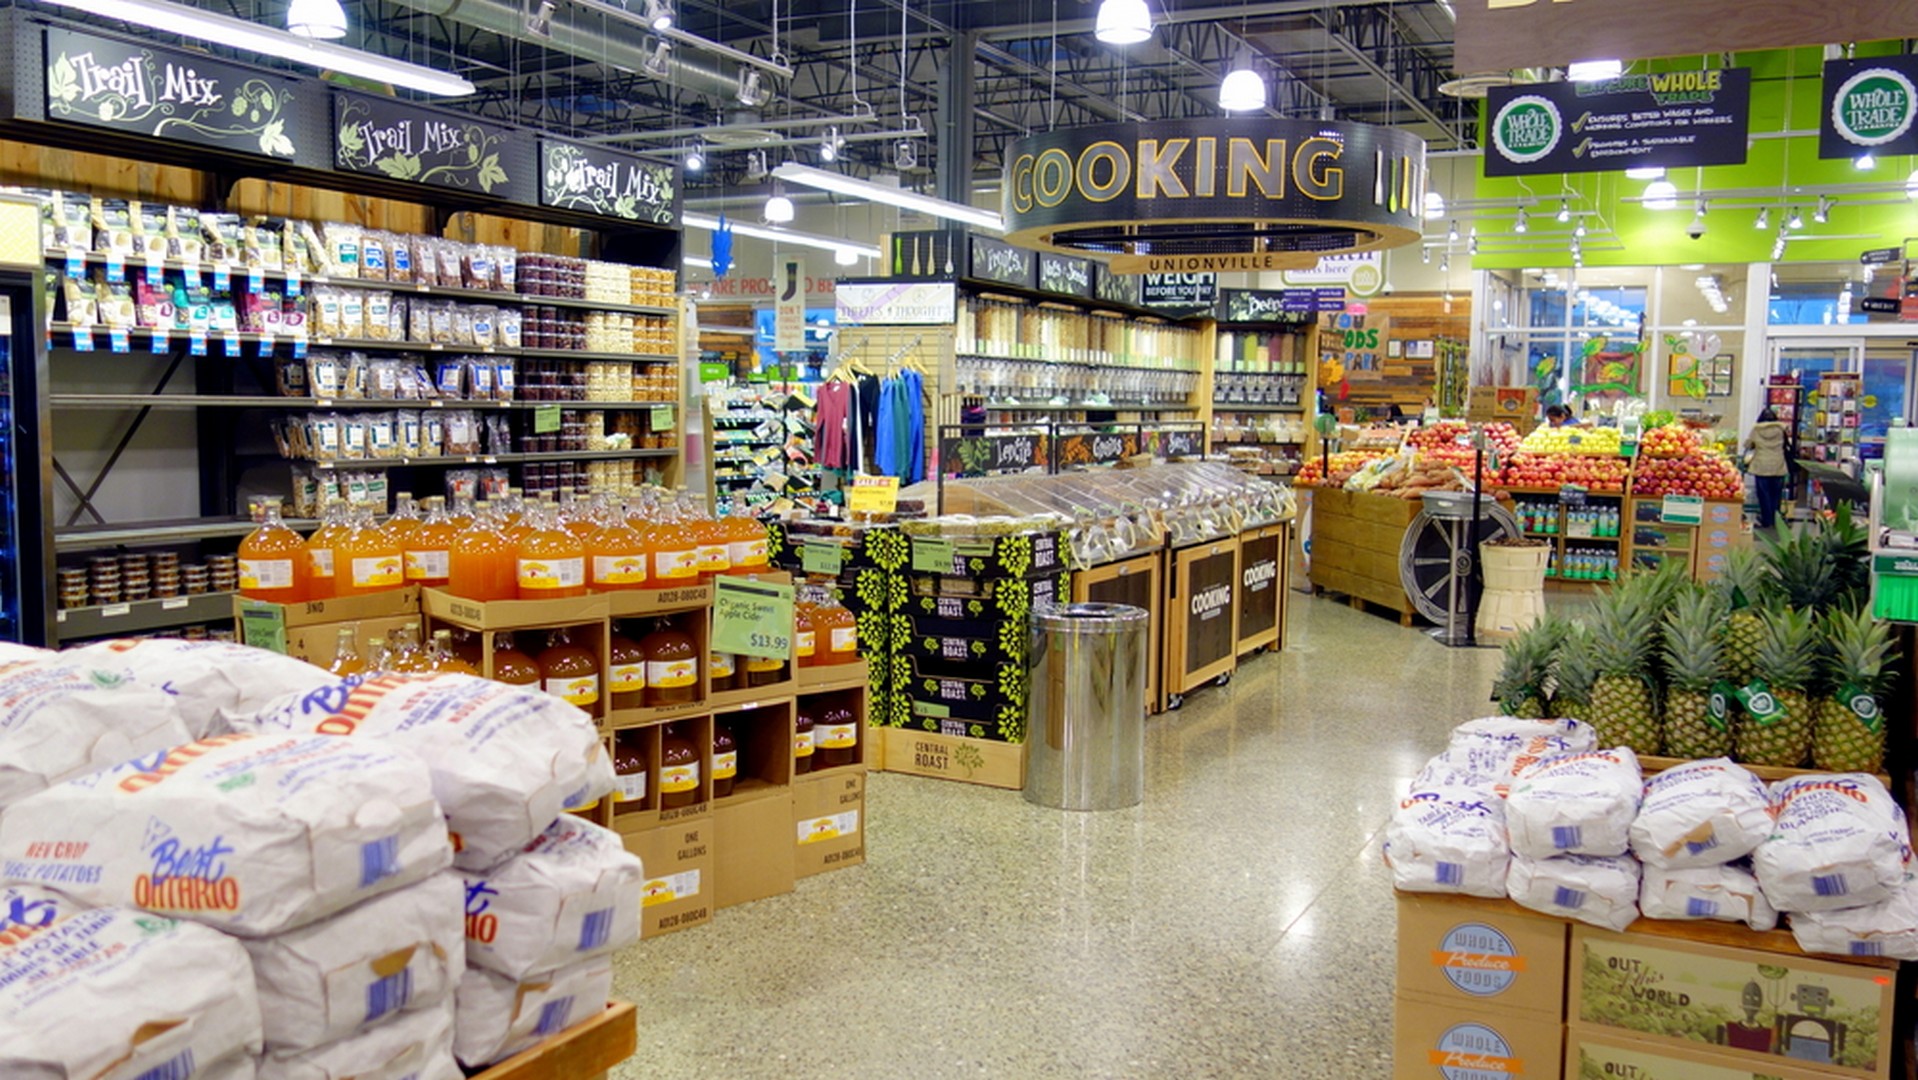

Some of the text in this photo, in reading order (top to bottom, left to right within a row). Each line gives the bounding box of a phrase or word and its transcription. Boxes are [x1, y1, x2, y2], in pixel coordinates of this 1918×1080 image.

[70, 52, 223, 110] Trail Mix
[1652, 70, 1722, 93] WHOLE
[1849, 87, 1906, 112] WHOLE
[1507, 109, 1549, 130] WHOLE
[1694, 107, 1714, 116] AND
[1846, 107, 1903, 129] TRADE
[358, 119, 465, 166] Trail Mix
[1505, 126, 1551, 143] TRADE
[572, 158, 663, 205] Trail Mix
[1010, 136, 1344, 215] COOKING
[1150, 256, 1273, 273] UNIONVILLE
[711, 279, 737, 295] ARE
[740, 277, 776, 295] PRO
[1146, 271, 1215, 286] WEIGH
[1145, 287, 1176, 297] BEFORE
[1177, 286, 1197, 296] YOU
[1342, 328, 1380, 350] ODS
[1344, 352, 1382, 372] PARK
[1243, 561, 1276, 587] COOKING
[1191, 585, 1230, 615] COOKING
[750, 633, 788, 650] $13.99
[915, 741, 949, 755] CENTRAL
[914, 753, 949, 770] ROAST
[684, 831, 699, 844] ONE
[24, 841, 51, 859] NEW
[150, 835, 235, 886] Best
[677, 845, 706, 862] GALLONS
[34, 864, 103, 884] POTATOES
[133, 873, 239, 911] ONTARIO
[1455, 932, 1505, 953] WHOLE
[1446, 947, 1511, 970] Produce
[1607, 956, 1643, 973] OUT
[1455, 969, 1501, 988] FOODS
[1630, 985, 1691, 1007] WORLD
[1451, 1032, 1502, 1054] WHOLE
[1443, 1046, 1507, 1070] Produce
[1604, 1061, 1639, 1080] OUT
